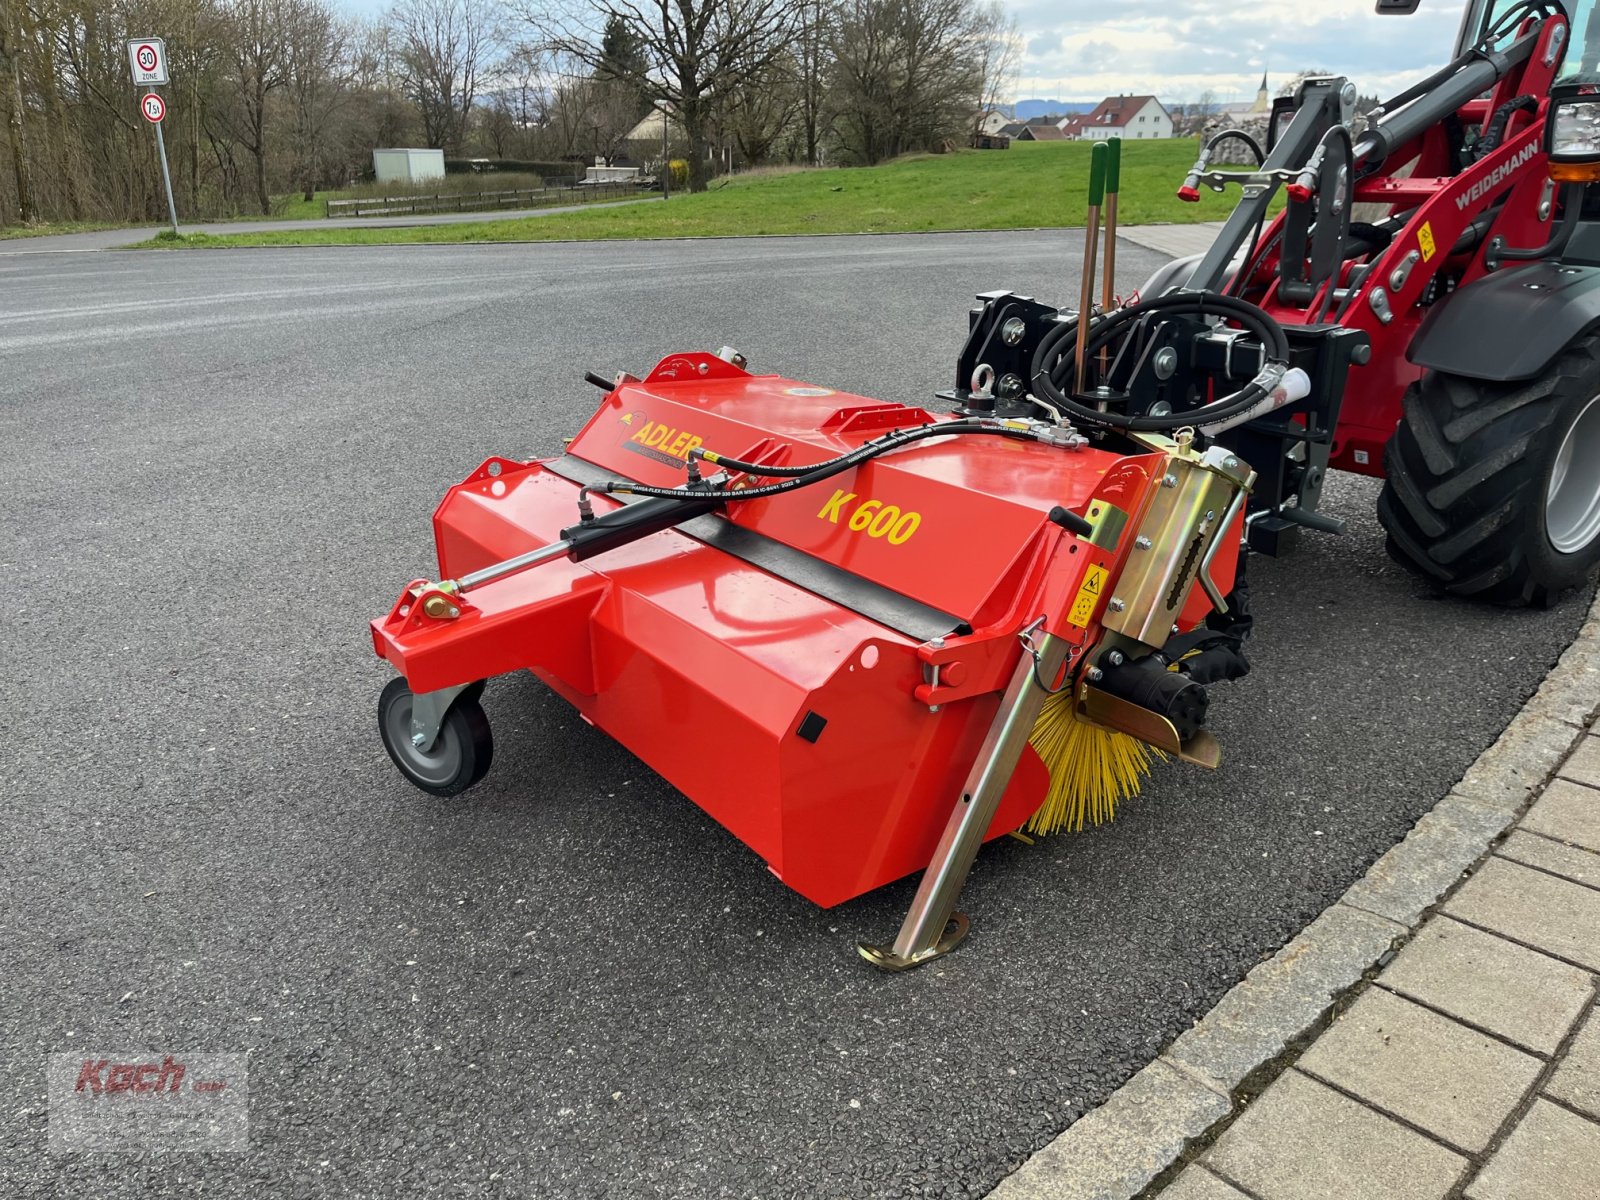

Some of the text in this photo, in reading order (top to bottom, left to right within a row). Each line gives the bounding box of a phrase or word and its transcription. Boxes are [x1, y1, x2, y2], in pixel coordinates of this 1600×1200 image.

[141, 52, 153, 64] 30
[1455, 139, 1538, 210] WEIDEMANN
[630, 421, 703, 460] ADLER
[817, 489, 921, 545] K 600
